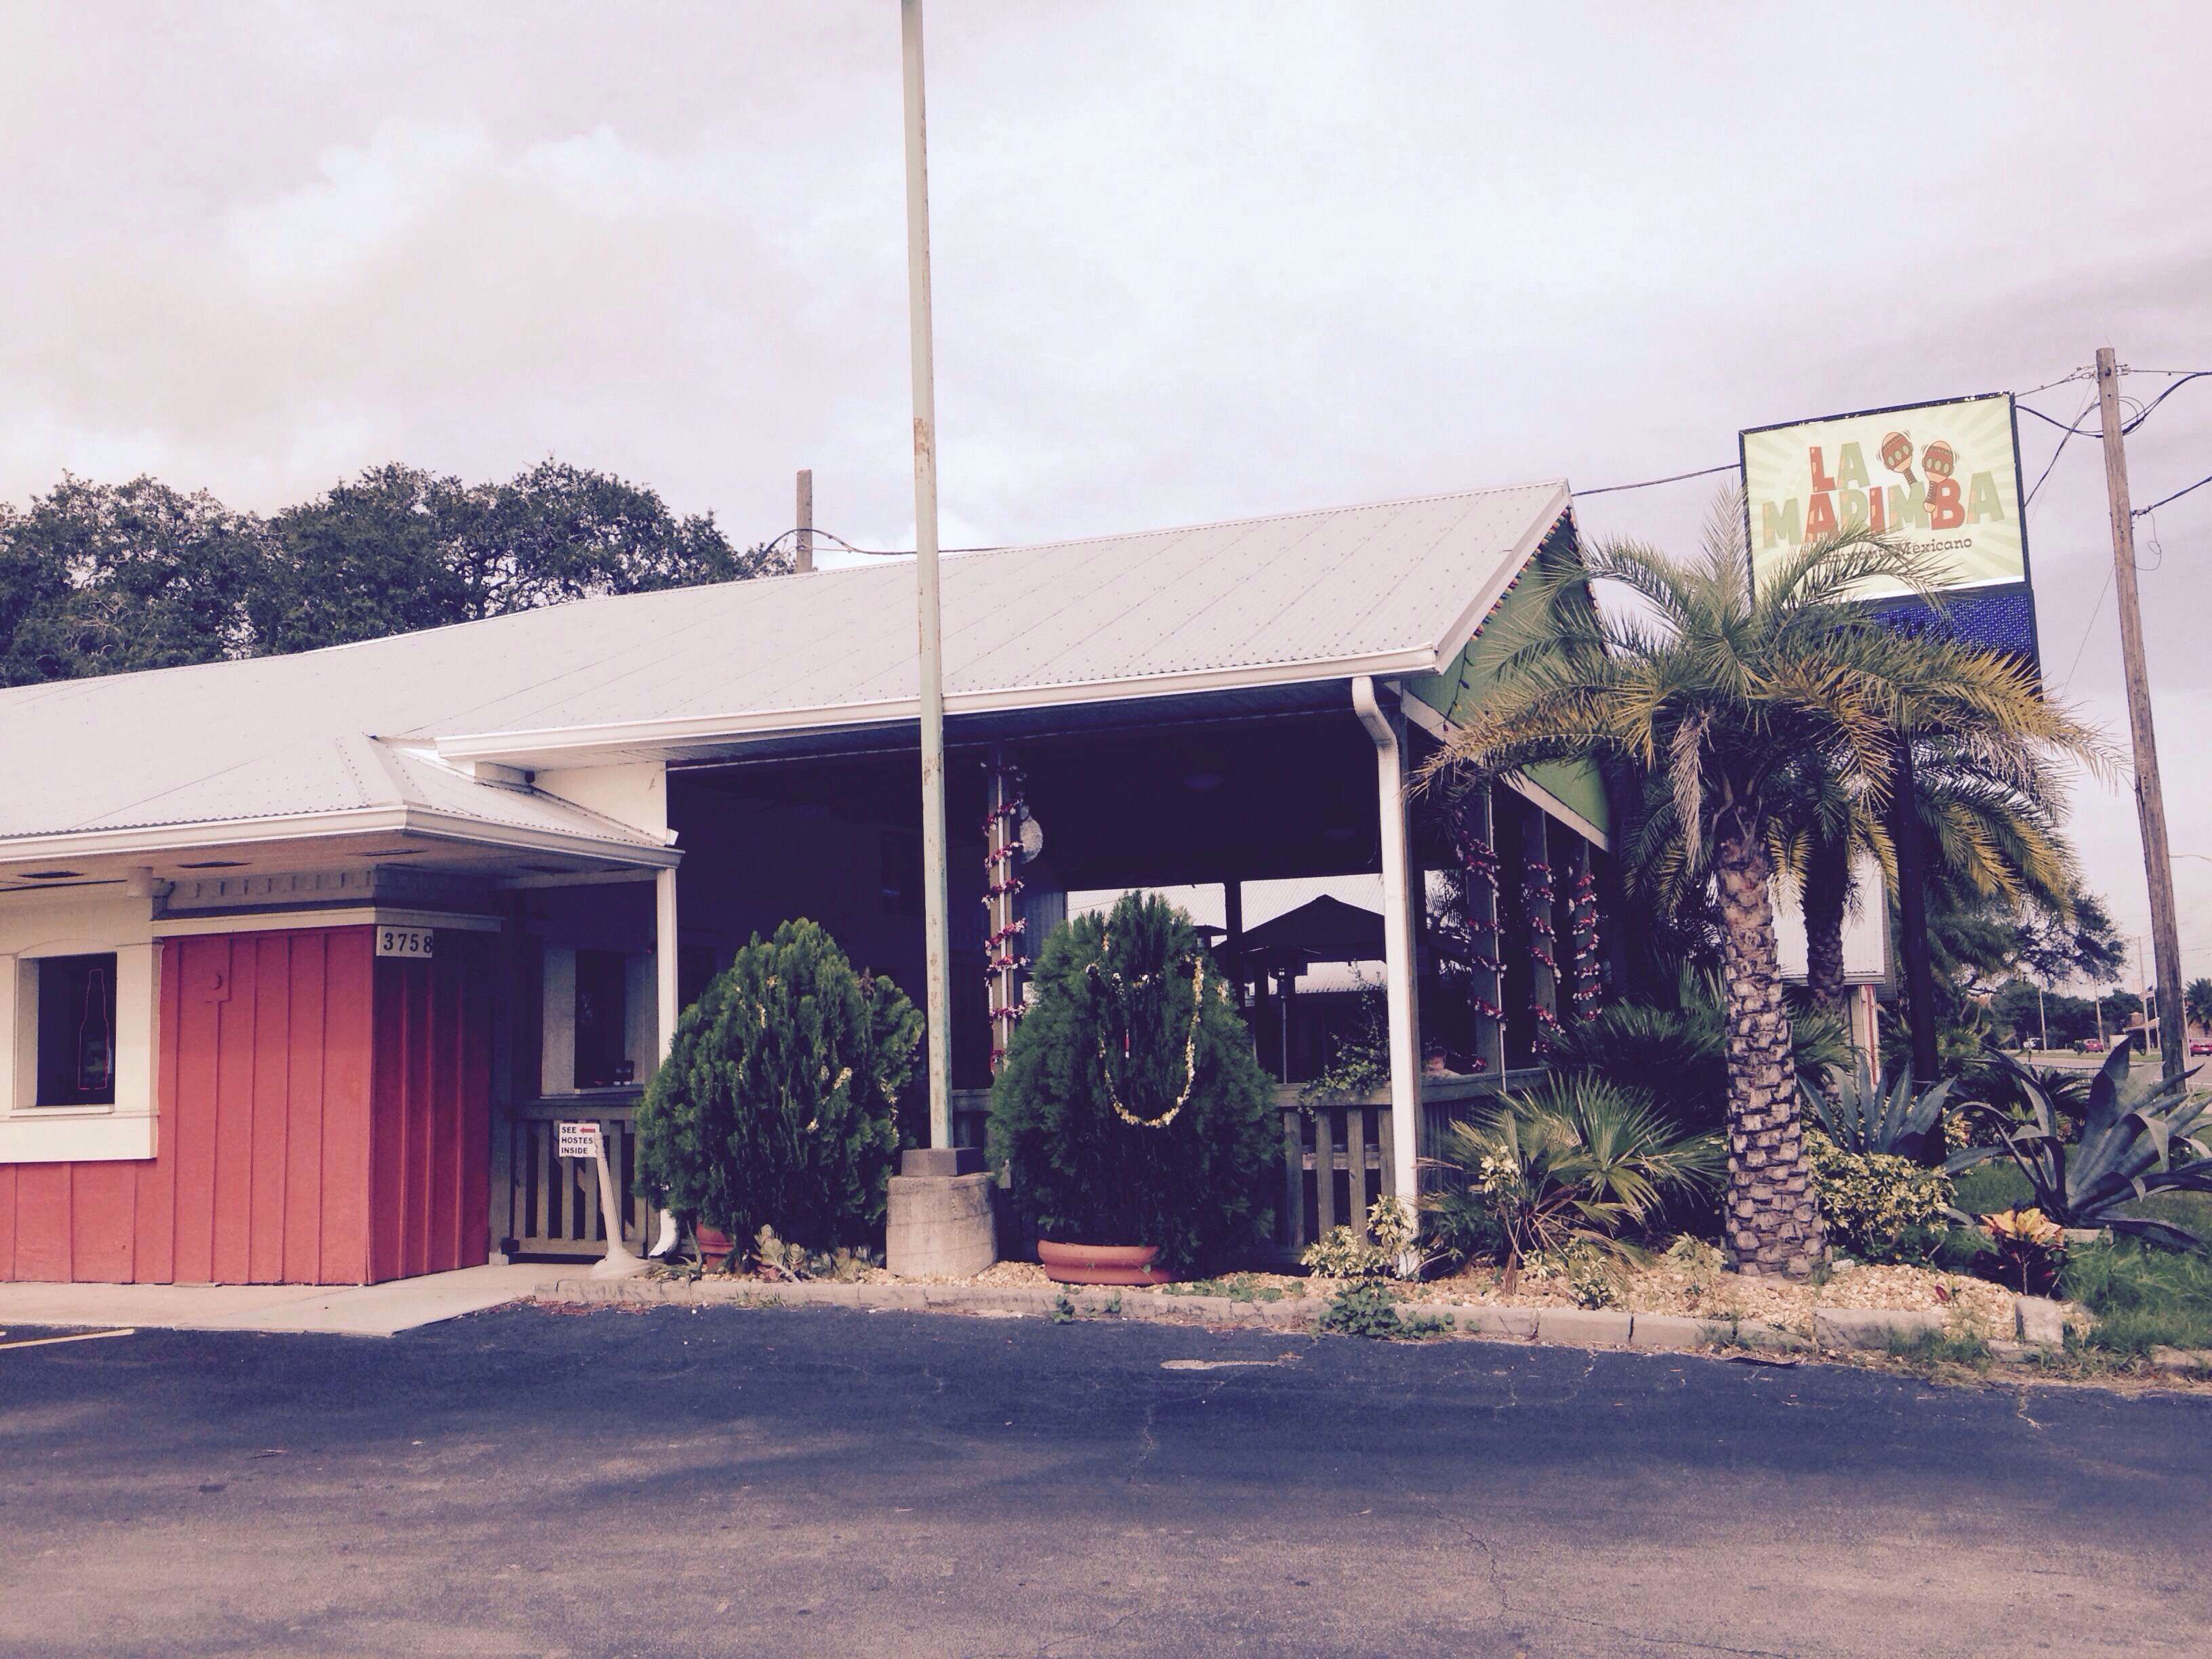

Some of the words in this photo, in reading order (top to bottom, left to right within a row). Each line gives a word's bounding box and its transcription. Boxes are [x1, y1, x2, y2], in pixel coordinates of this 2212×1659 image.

[1809, 442, 1870, 492] LA
[1762, 471, 2005, 548] MARIMBA
[1894, 538, 1972, 554] Mexicano
[383, 932, 432, 953] 3758
